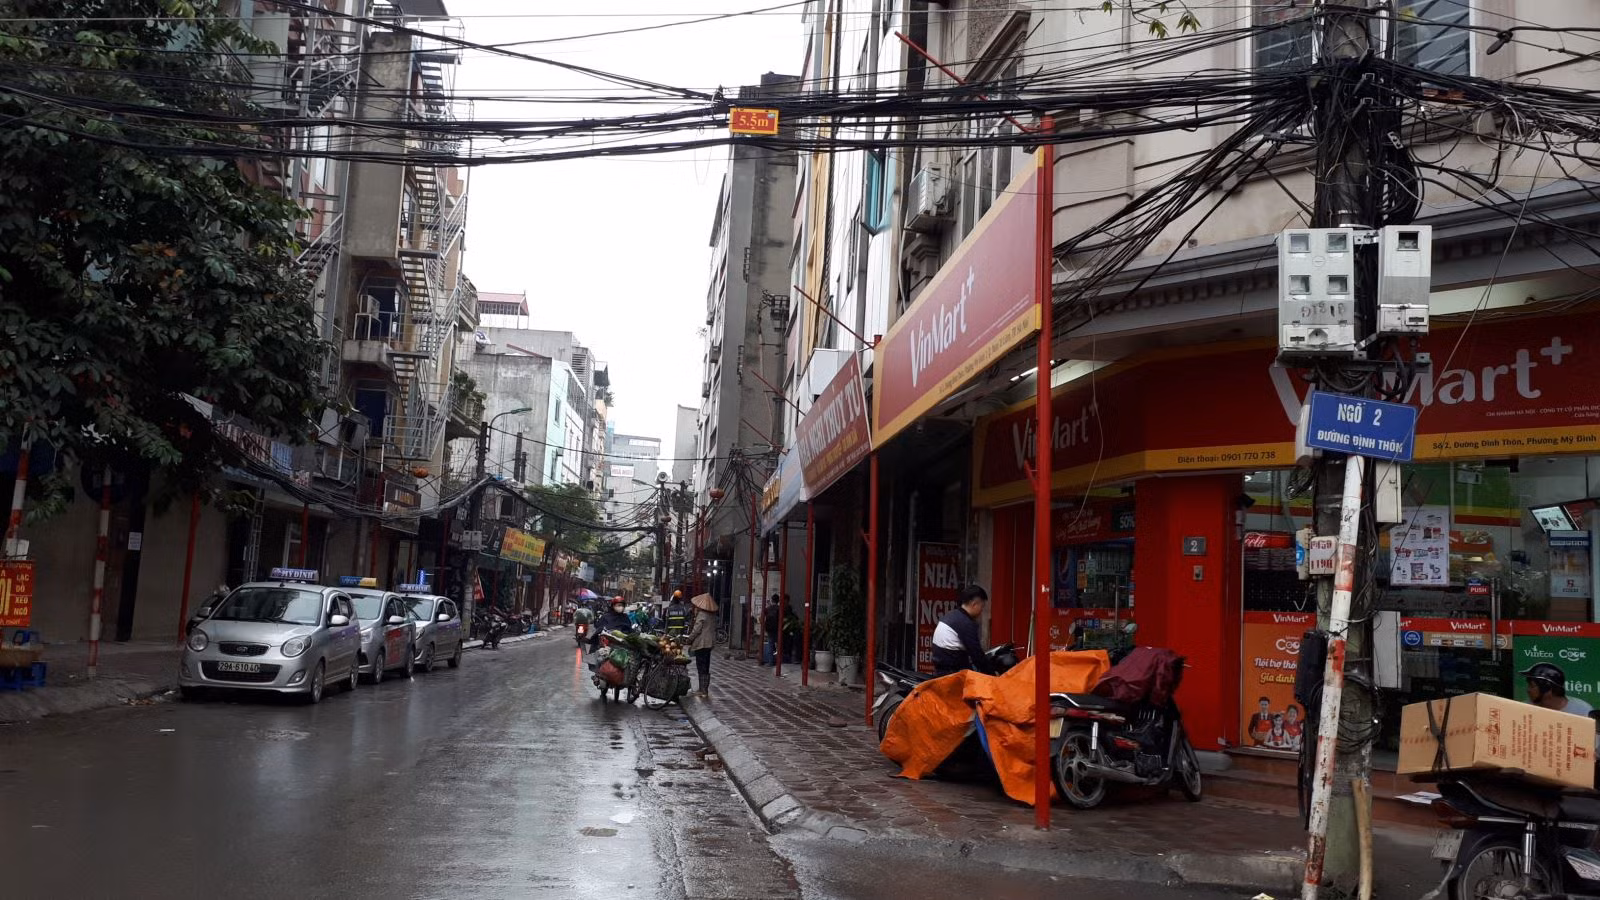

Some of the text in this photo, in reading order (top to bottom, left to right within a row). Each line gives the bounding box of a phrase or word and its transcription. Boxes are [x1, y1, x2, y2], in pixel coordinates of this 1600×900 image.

[739, 114, 769, 127] 5.5m
[1269, 336, 1573, 427] VMart+
[1337, 402, 1383, 426] NGÕ 2
[1317, 429, 1350, 445] ĐƯỜNG
[1378, 439, 1403, 453] THÔN
[1221, 453, 1242, 462] 0901
[1243, 452, 1259, 460] 770
[1261, 451, 1277, 460] 738
[1190, 540, 1198, 552] 2
[924, 557, 958, 589] NHÀ
